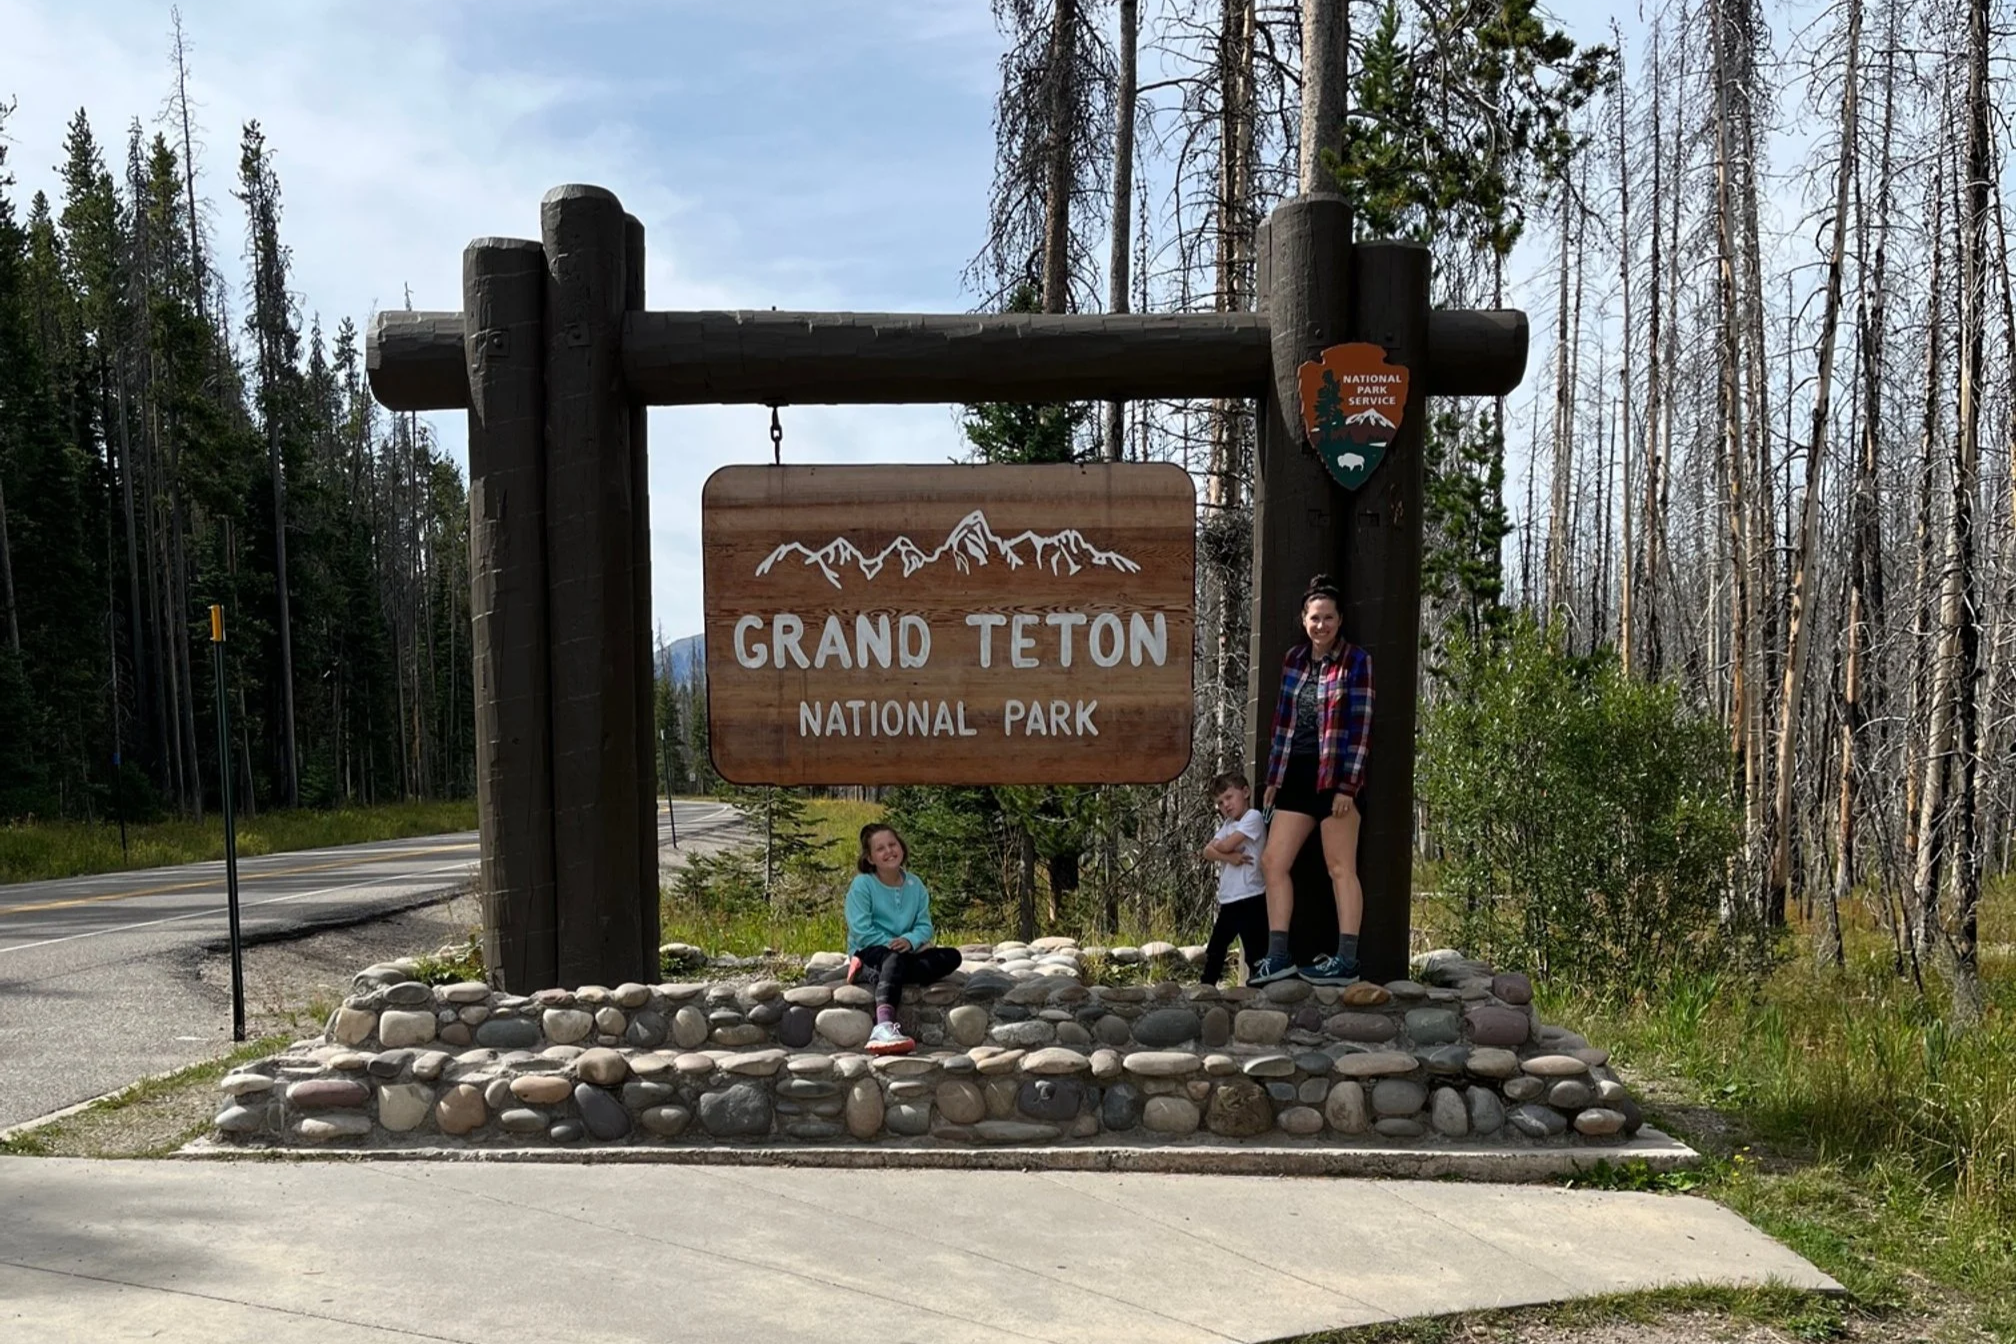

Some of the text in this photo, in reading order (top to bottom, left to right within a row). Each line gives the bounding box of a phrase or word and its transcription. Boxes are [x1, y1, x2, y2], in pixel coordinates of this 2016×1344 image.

[1342, 374, 1402, 384] NATIONAL
[1356, 385, 1387, 394] PARK
[1348, 396, 1396, 405] SERVICE
[733, 612, 1168, 670] GRAND TETON
[799, 698, 1099, 738] NATIONAL PARK
